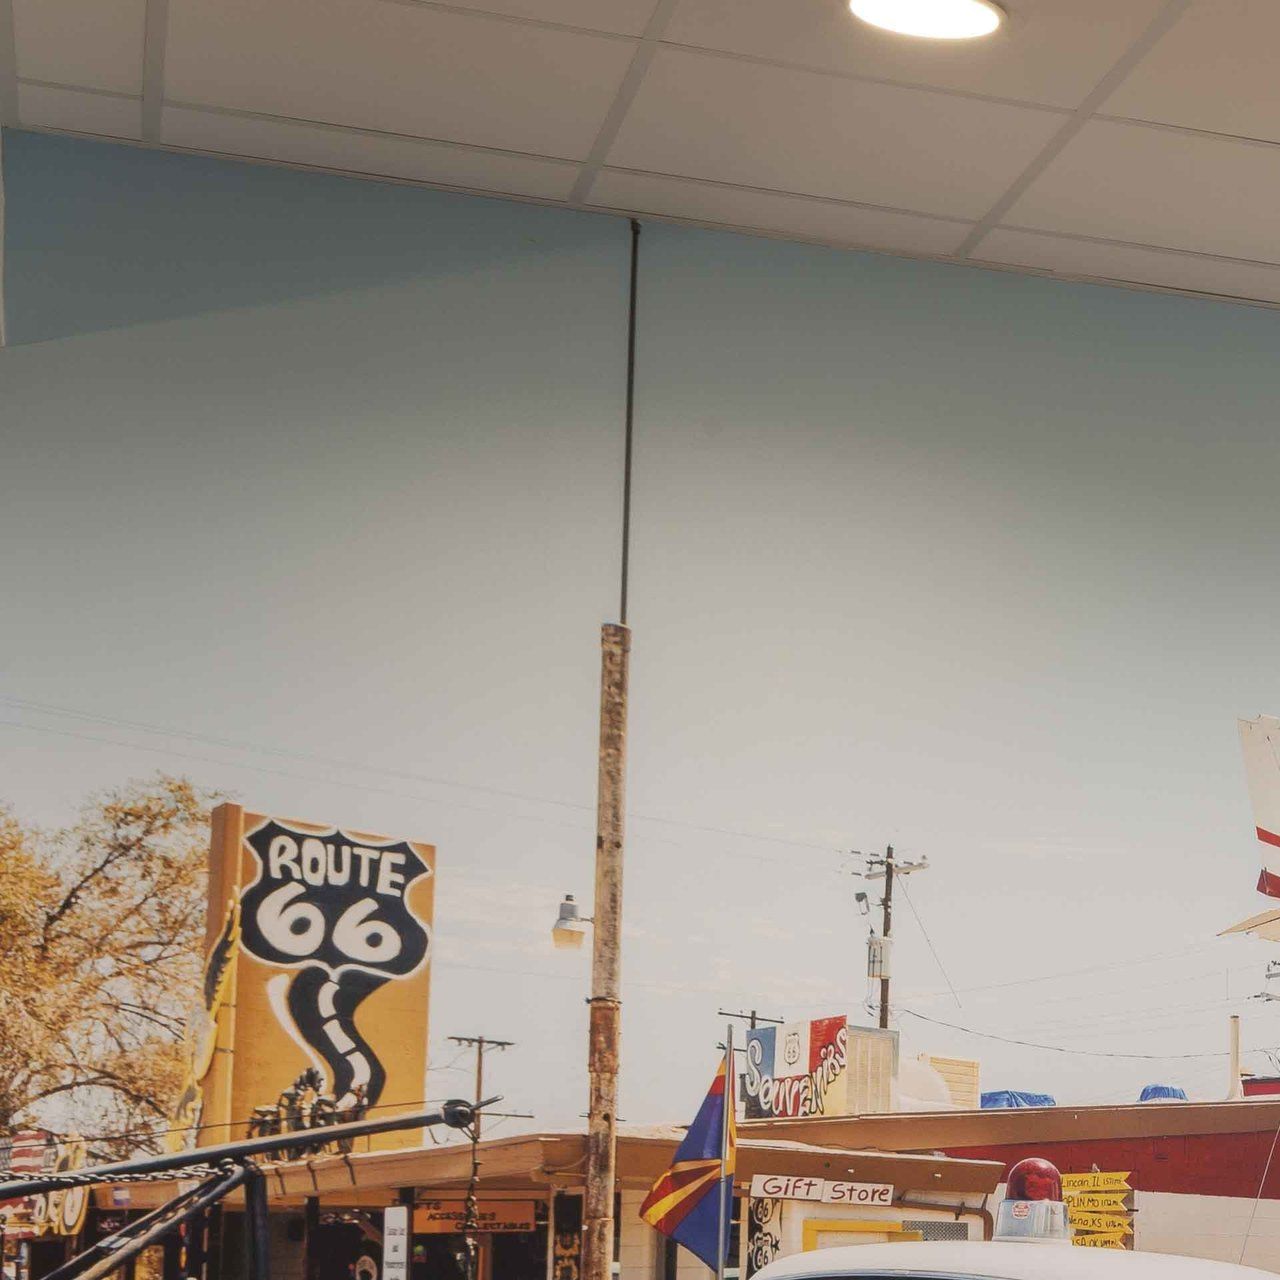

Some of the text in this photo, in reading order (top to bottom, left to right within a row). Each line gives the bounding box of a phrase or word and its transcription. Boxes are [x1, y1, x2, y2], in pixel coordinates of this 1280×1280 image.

[268, 834, 406, 897] ROUTE
[256, 881, 402, 963] 66
[754, 1200, 770, 1219] 66
[763, 1177, 891, 1202] Gift Store
